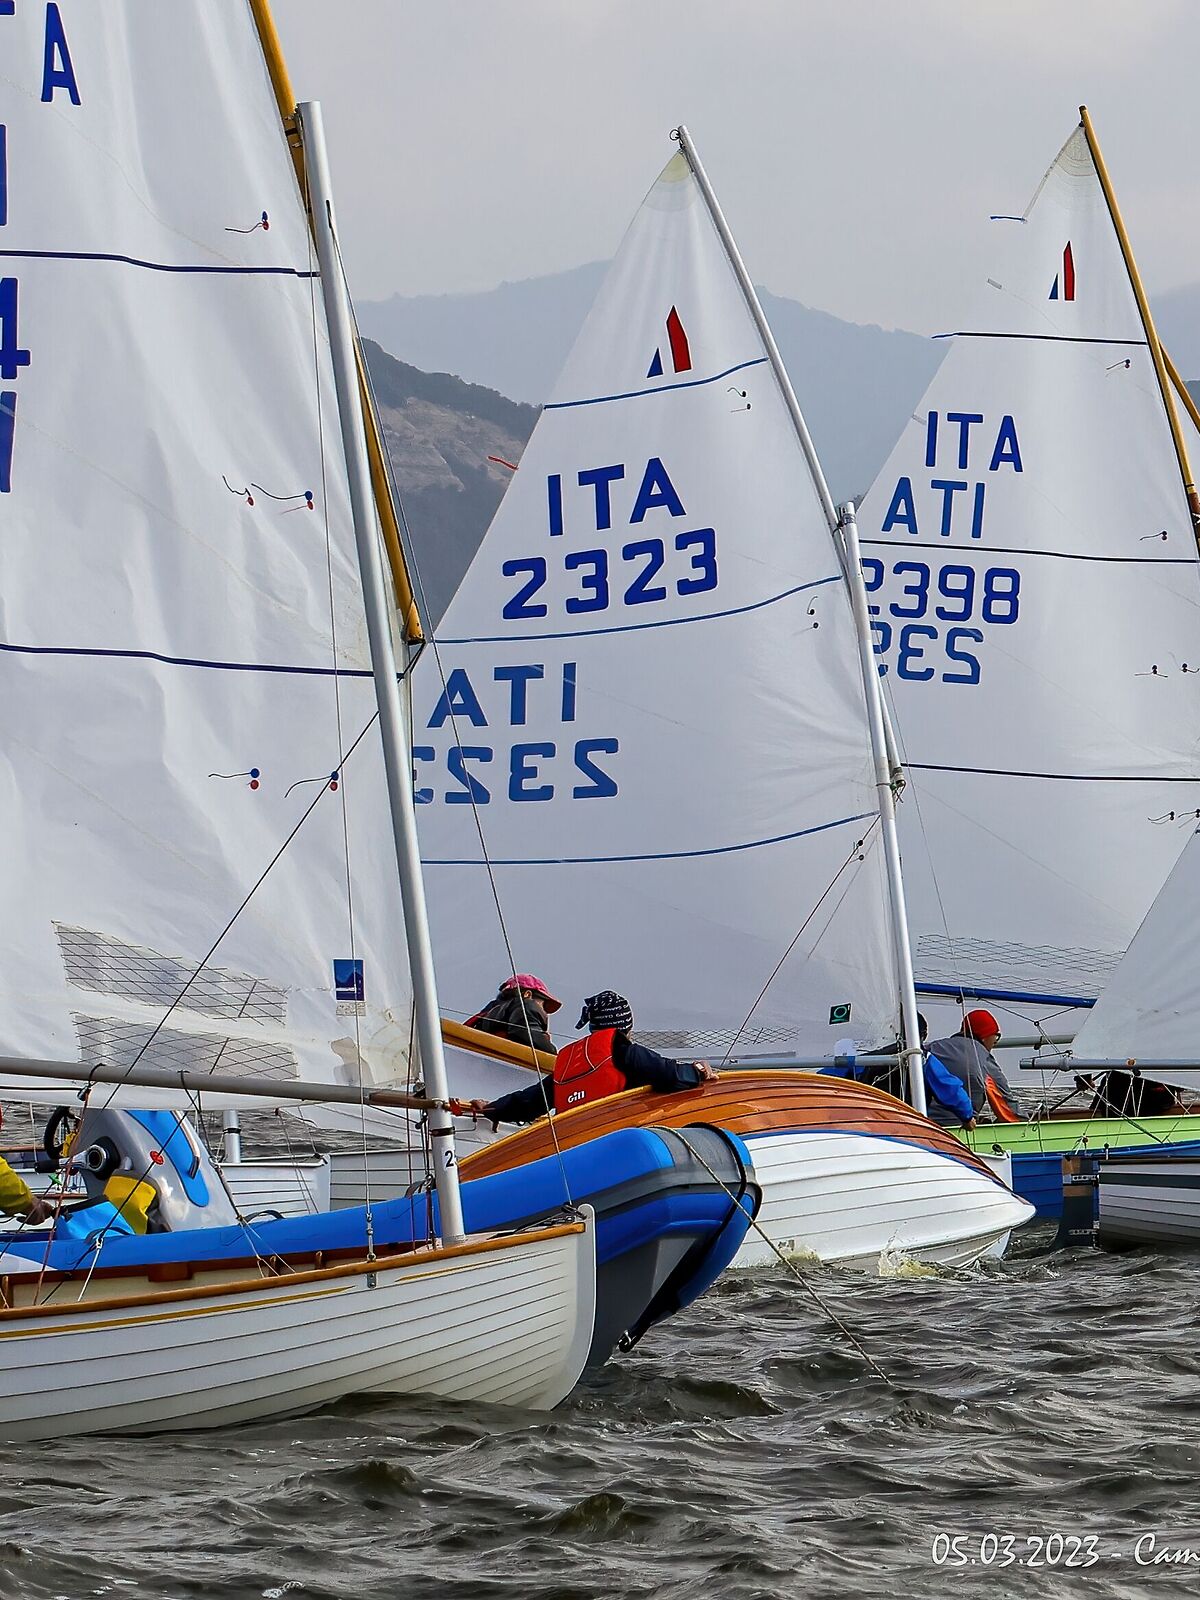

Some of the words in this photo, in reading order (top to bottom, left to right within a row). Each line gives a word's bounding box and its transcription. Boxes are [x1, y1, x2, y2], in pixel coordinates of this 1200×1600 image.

[926, 411, 1024, 472] ITA
[547, 457, 687, 536] ITA
[502, 528, 718, 620] 2323
[568, 1091, 585, 1103] Gill
[445, 1150, 454, 1167] 2
